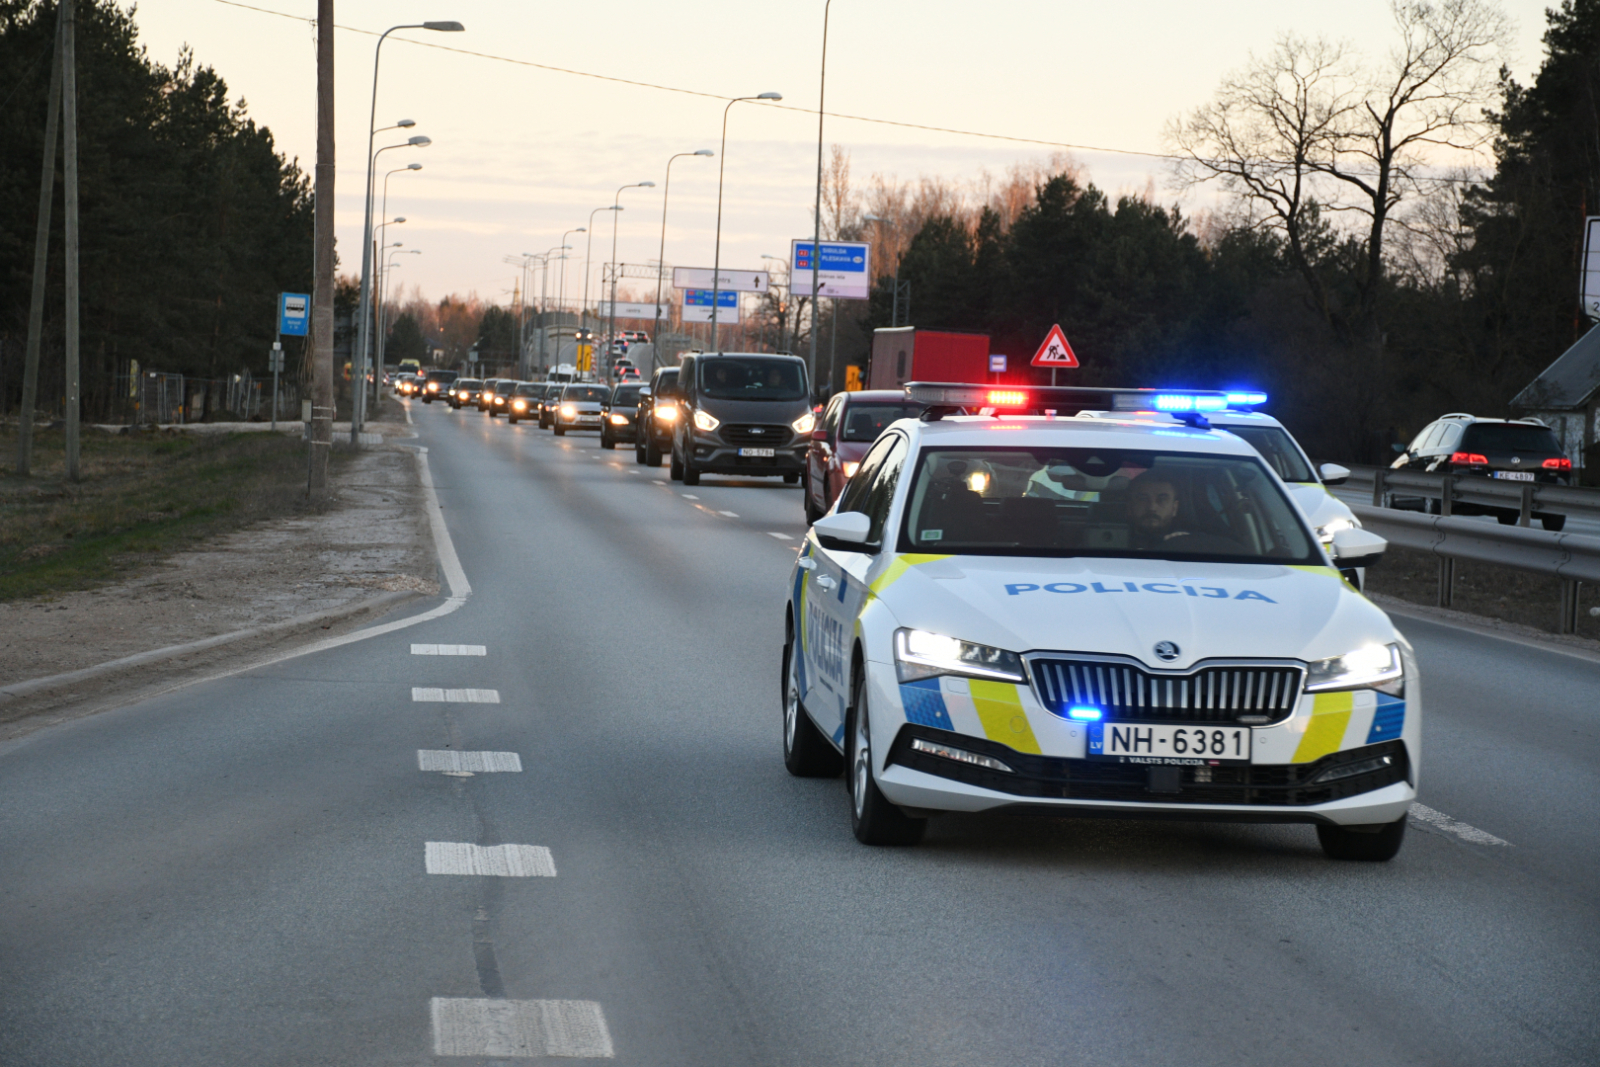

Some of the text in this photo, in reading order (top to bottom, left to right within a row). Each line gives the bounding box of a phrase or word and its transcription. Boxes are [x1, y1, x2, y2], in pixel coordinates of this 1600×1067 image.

[1499, 472, 1534, 481] KE-4897
[1004, 582, 1279, 604] POLICIJA
[1090, 726, 1242, 756] LV NH-6381
[1128, 757, 1205, 766] VALSTS POLICIJA
